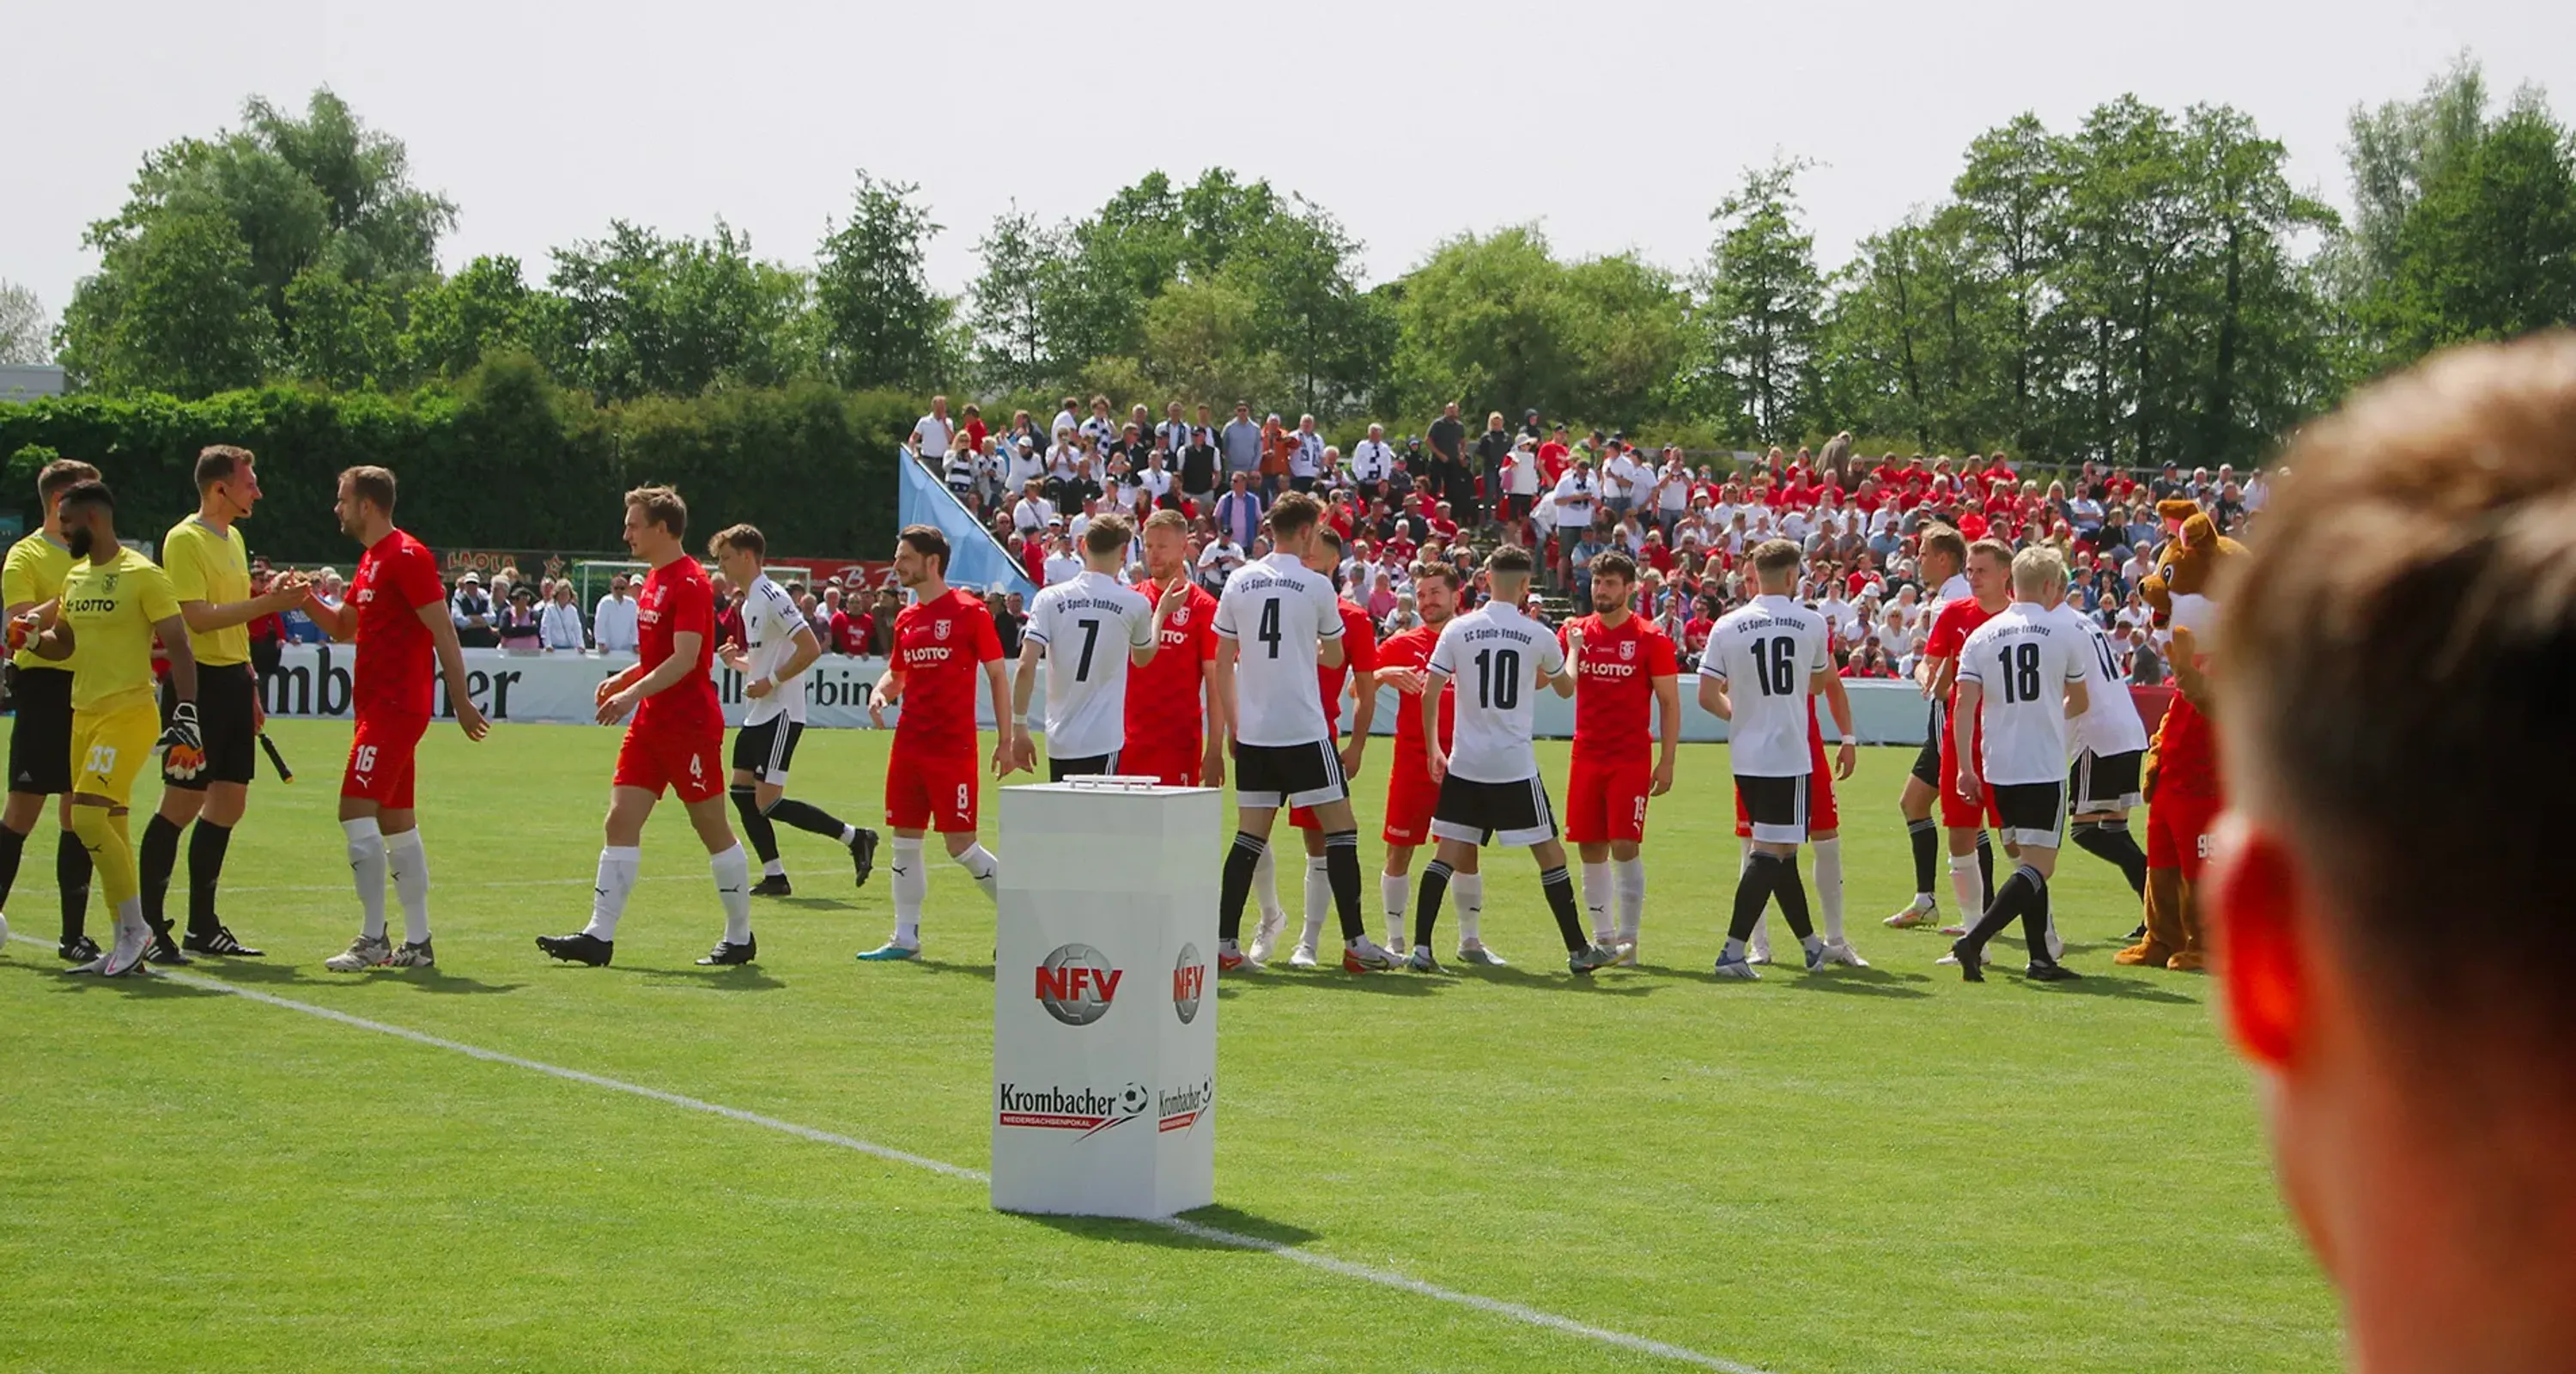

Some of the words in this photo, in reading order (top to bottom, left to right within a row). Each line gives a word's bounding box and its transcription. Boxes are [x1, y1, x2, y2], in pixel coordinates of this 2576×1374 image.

[76, 599, 115, 611] LOTTO
[1067, 598, 1124, 615] Spelle-Venhaus
[1160, 629, 1185, 644] TTO
[1259, 597, 1281, 659] 4
[1464, 631, 1474, 643] SC
[1476, 628, 1532, 645] Spelle-Venhaus
[1737, 622, 1748, 634] SC
[1748, 616, 1806, 631] Spelle-Venhaus
[911, 647, 950, 661] LOTTO
[1076, 619, 1100, 682] 7
[2091, 631, 2119, 682] 17
[1474, 648, 1520, 709] 10
[1591, 661, 1633, 677] LOTTO
[1750, 636, 1795, 696] 16
[1998, 642, 2039, 703] 18
[87, 745, 118, 774] 33
[355, 744, 378, 772] 16
[690, 752, 702, 779] 4
[957, 782, 969, 809] 8
[1036, 967, 1122, 1002] NFV
[1174, 965, 1205, 1002] NFV
[1000, 1084, 1116, 1116] Krombacher
[1159, 1085, 1201, 1117] Krombacher
[1003, 1116, 1091, 1127] NIEDERSACHSENPOKAL
